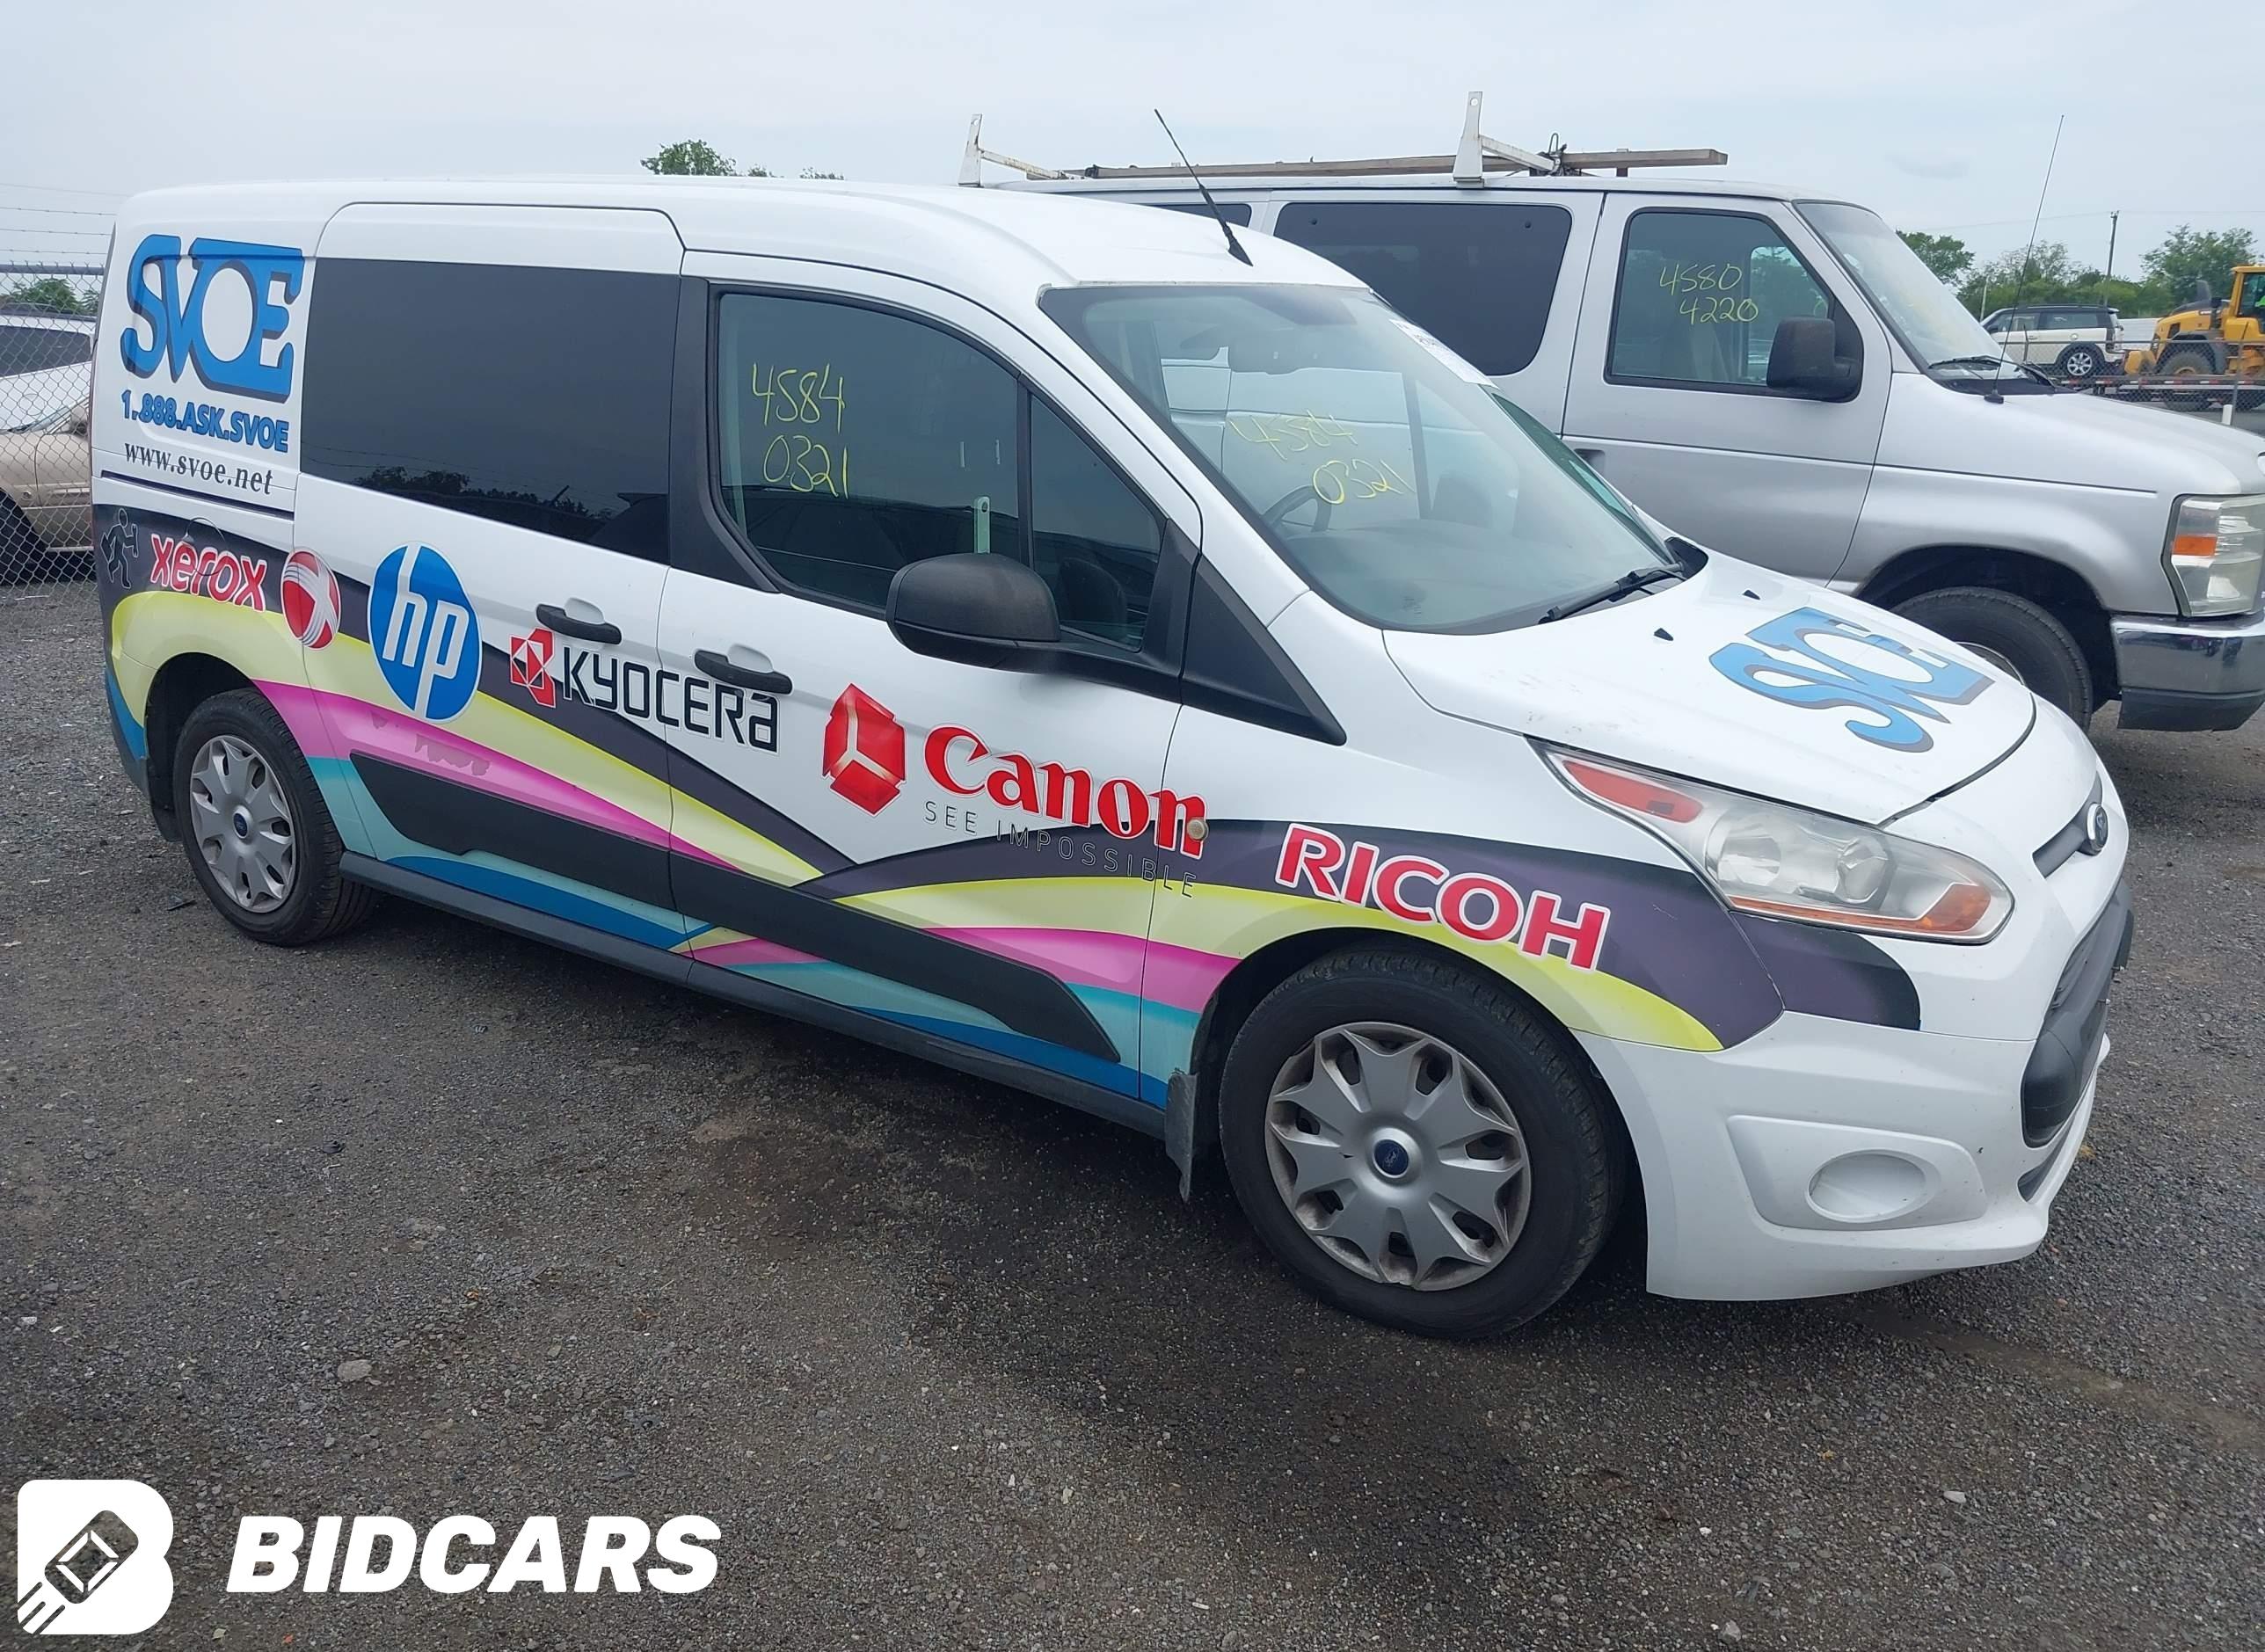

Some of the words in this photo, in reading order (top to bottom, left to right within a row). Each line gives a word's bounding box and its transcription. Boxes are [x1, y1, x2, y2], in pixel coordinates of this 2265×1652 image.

[120, 234, 305, 404] SVOE
[1659, 263, 1743, 296] 4580
[1679, 296, 1759, 325] 4220
[121, 389, 289, 454] 1.888.ASK.SVOE
[752, 362, 846, 434] 4584
[124, 442, 273, 495] www.svoe.net
[763, 434, 848, 499] 0321
[149, 532, 267, 612] xerox
[382, 542, 470, 719] hp
[1709, 607, 1996, 753] SVOE
[924, 724, 1207, 859] Canon
[924, 800, 978, 836] SEE
[996, 819, 1198, 898] IMPOSSIBLE
[1276, 823, 1611, 971] RICOH
